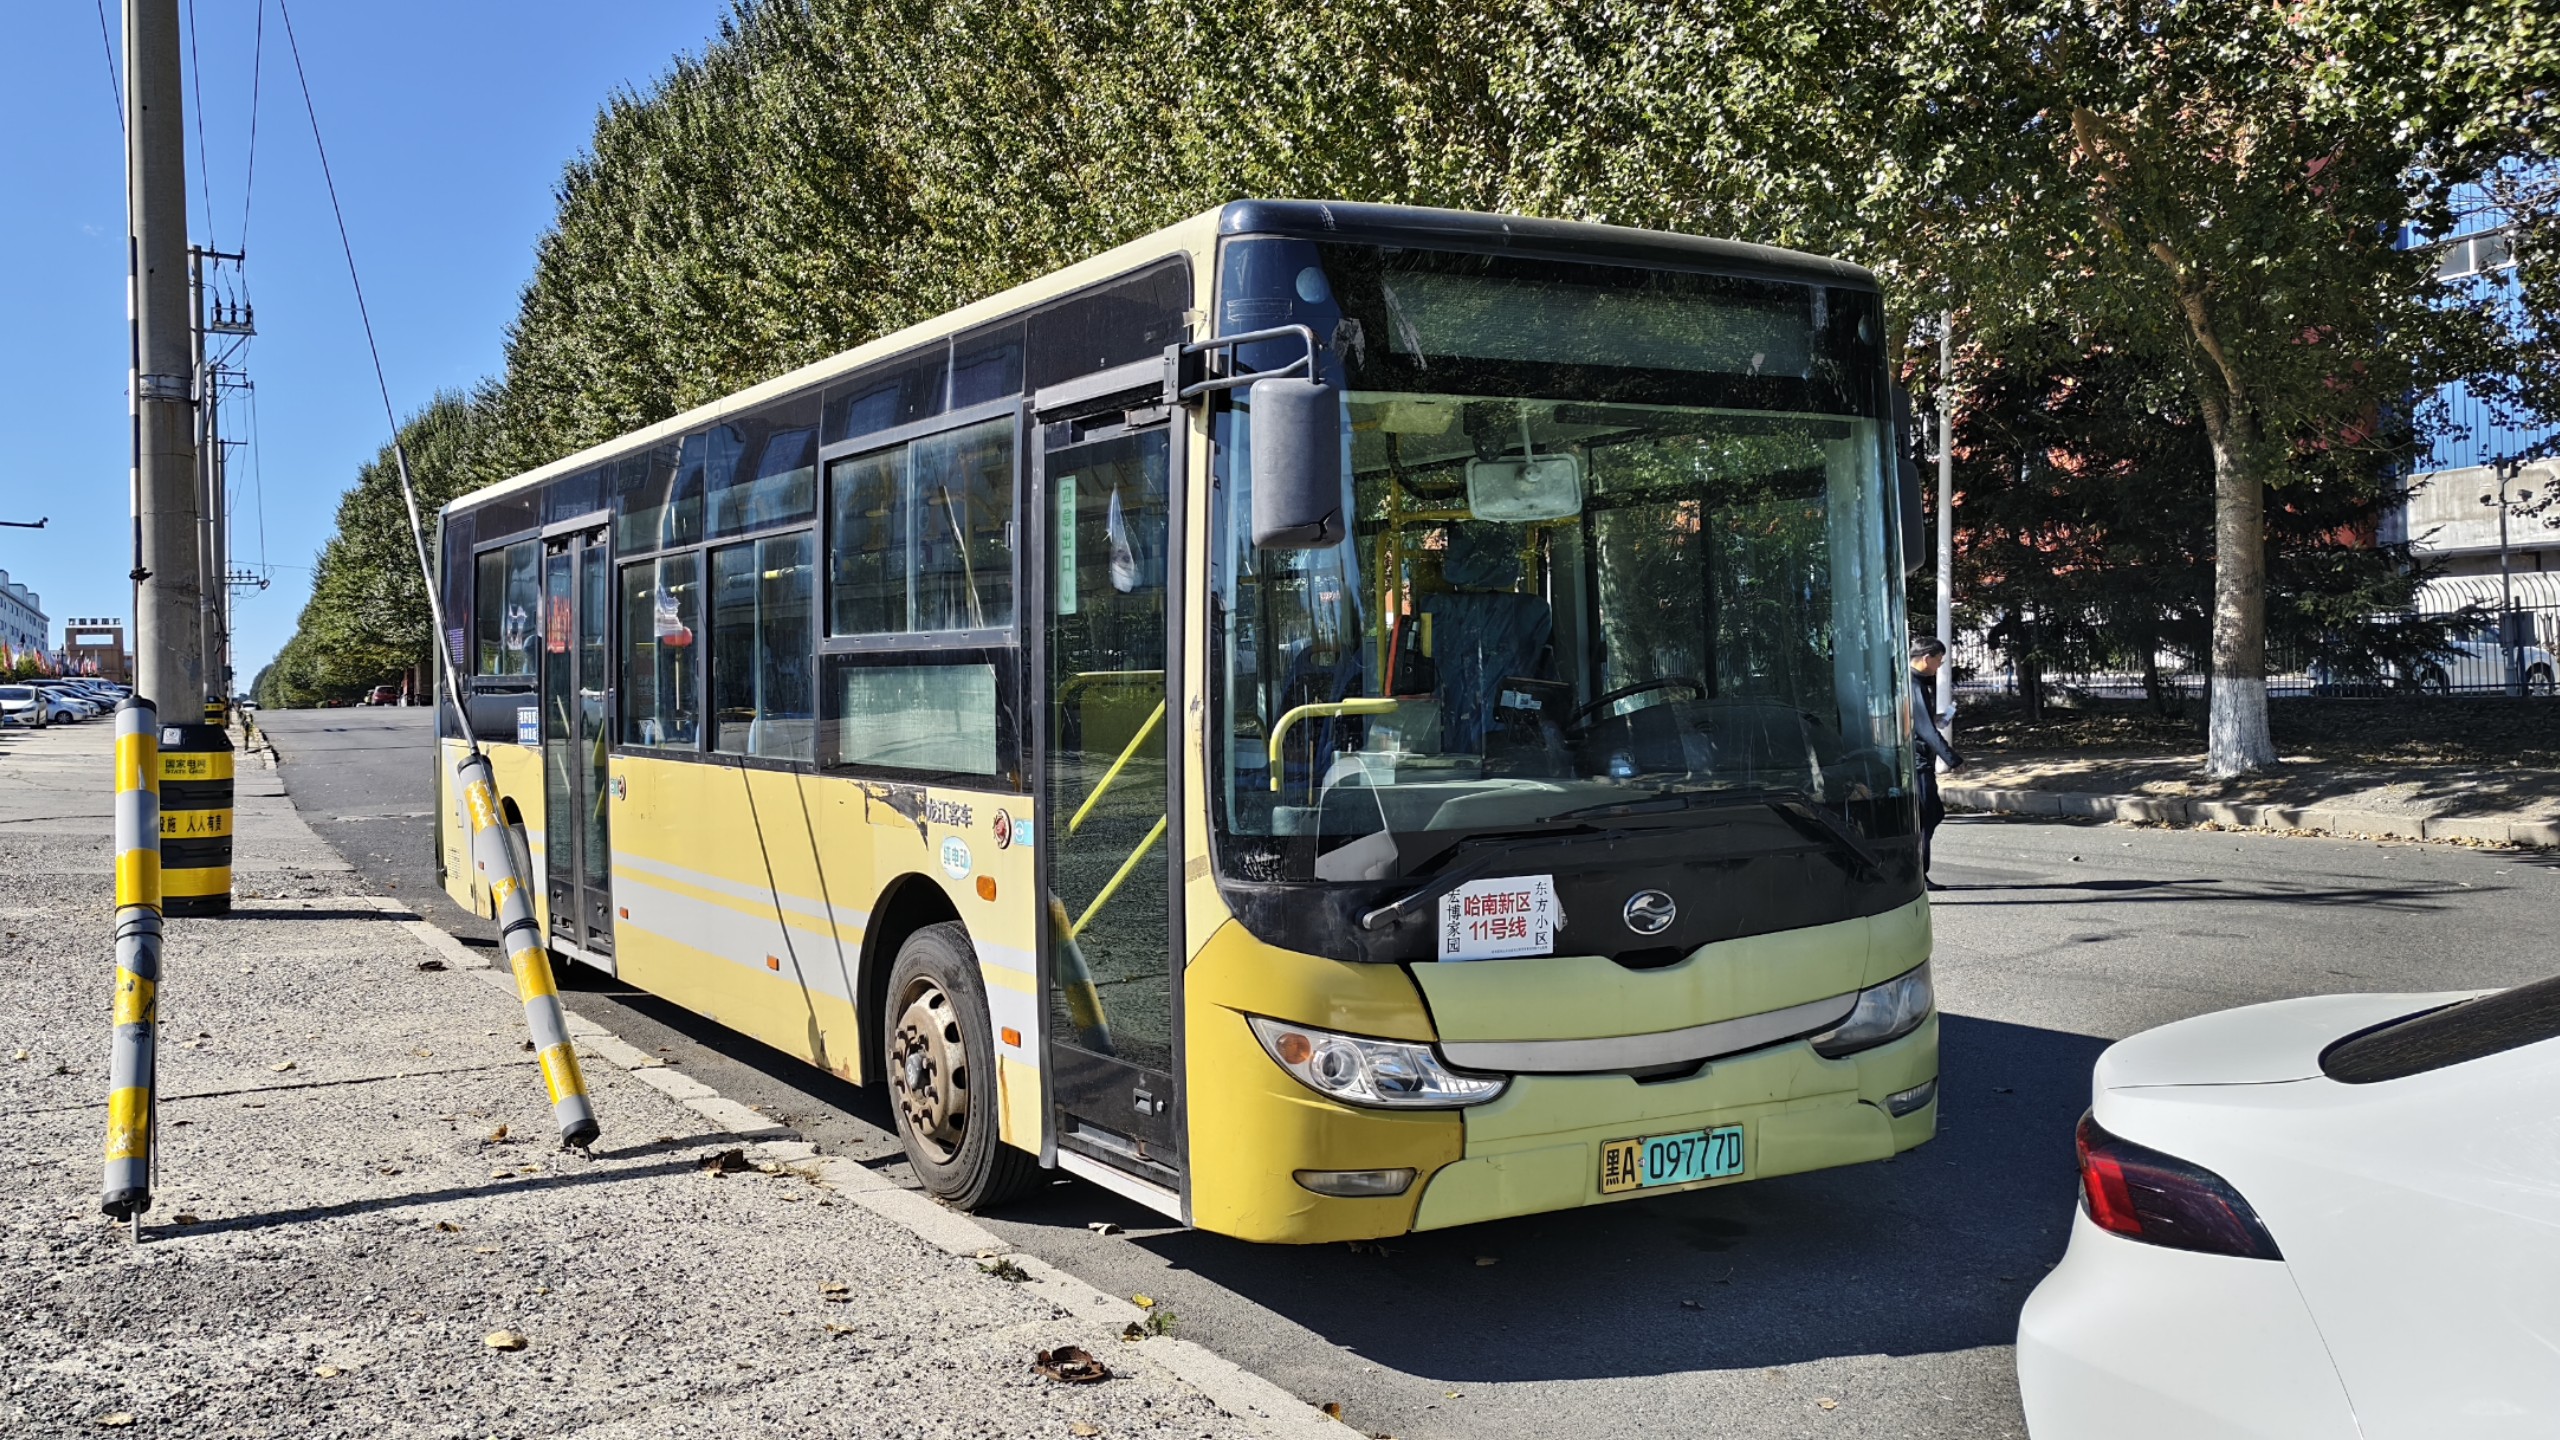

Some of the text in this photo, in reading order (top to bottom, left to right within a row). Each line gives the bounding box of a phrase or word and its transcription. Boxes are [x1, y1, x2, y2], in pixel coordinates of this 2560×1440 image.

[165, 759, 206, 769] 国家电网
[187, 815, 222, 833] 人人有责
[1464, 891, 1531, 917] 哈南新区
[1535, 881, 1548, 946] 东方小区
[1446, 888, 1461, 954] 宏博家园
[1468, 916, 1527, 941] 11号线
